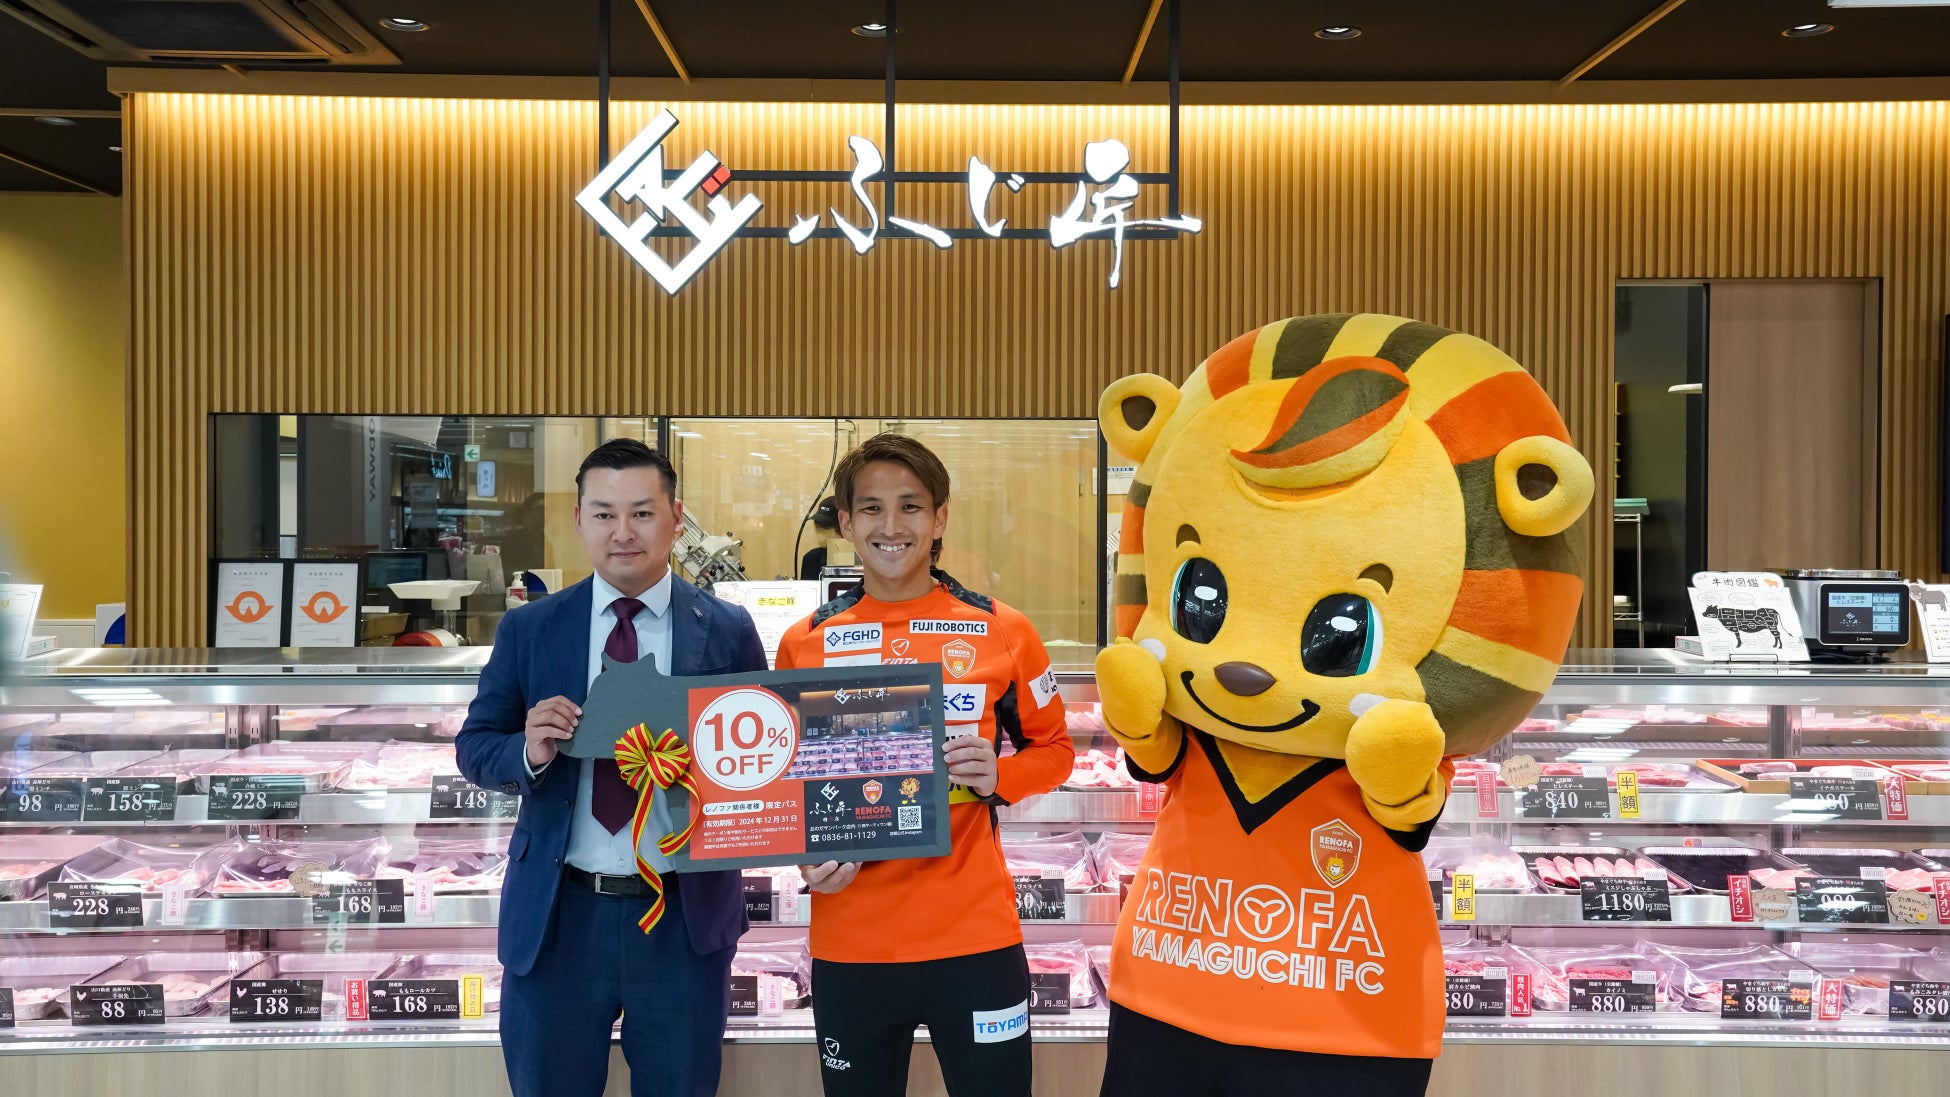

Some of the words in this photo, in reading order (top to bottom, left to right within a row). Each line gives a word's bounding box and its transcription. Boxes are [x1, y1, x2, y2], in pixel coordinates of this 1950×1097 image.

[789, 135, 1202, 289] ふじ匠
[842, 629, 881, 642] FGHD
[912, 622, 934, 632] FUJI
[935, 622, 986, 634] ROBOTICS
[704, 710, 789, 752] 10%
[715, 753, 774, 777] OFF
[108, 793, 143, 812] 158
[231, 791, 267, 810] 228
[453, 791, 487, 809] 148
[1145, 783, 1154, 810] 玉商品
[1545, 791, 1579, 809] 840
[1620, 776, 1637, 810] 半額
[1887, 778, 1903, 812] 大特価
[19, 794, 42, 812] 98
[855, 805, 892, 816] RENOFA
[821, 830, 877, 842] 0836-81-1129
[1319, 835, 1354, 849] RENOFA
[1319, 844, 1347, 853] YAMAGUCHI
[337, 896, 372, 913] 168
[1456, 878, 1472, 912] 半額
[1599, 892, 1645, 911] 1180
[1733, 878, 1745, 914] イチオシ
[1937, 881, 1950, 916] イチオシ
[73, 898, 109, 916] 228
[116, 906, 123, 914] 円
[1136, 867, 1386, 958] RENOFA
[1131, 925, 1327, 991] YAMAGUCHI
[1335, 958, 1385, 996] FC
[253, 996, 289, 1015] 138
[295, 1006, 303, 1014] 円
[350, 981, 360, 1016] お買い得品
[392, 995, 428, 1013] 168
[1044, 1000, 1052, 1008] 円
[1591, 995, 1625, 1013] 880
[1744, 995, 1780, 1013] 880
[1824, 982, 1838, 1015] 大特価
[1912, 997, 1949, 1016] 880
[101, 1001, 126, 1018] 88
[138, 1009, 146, 1017] 円
